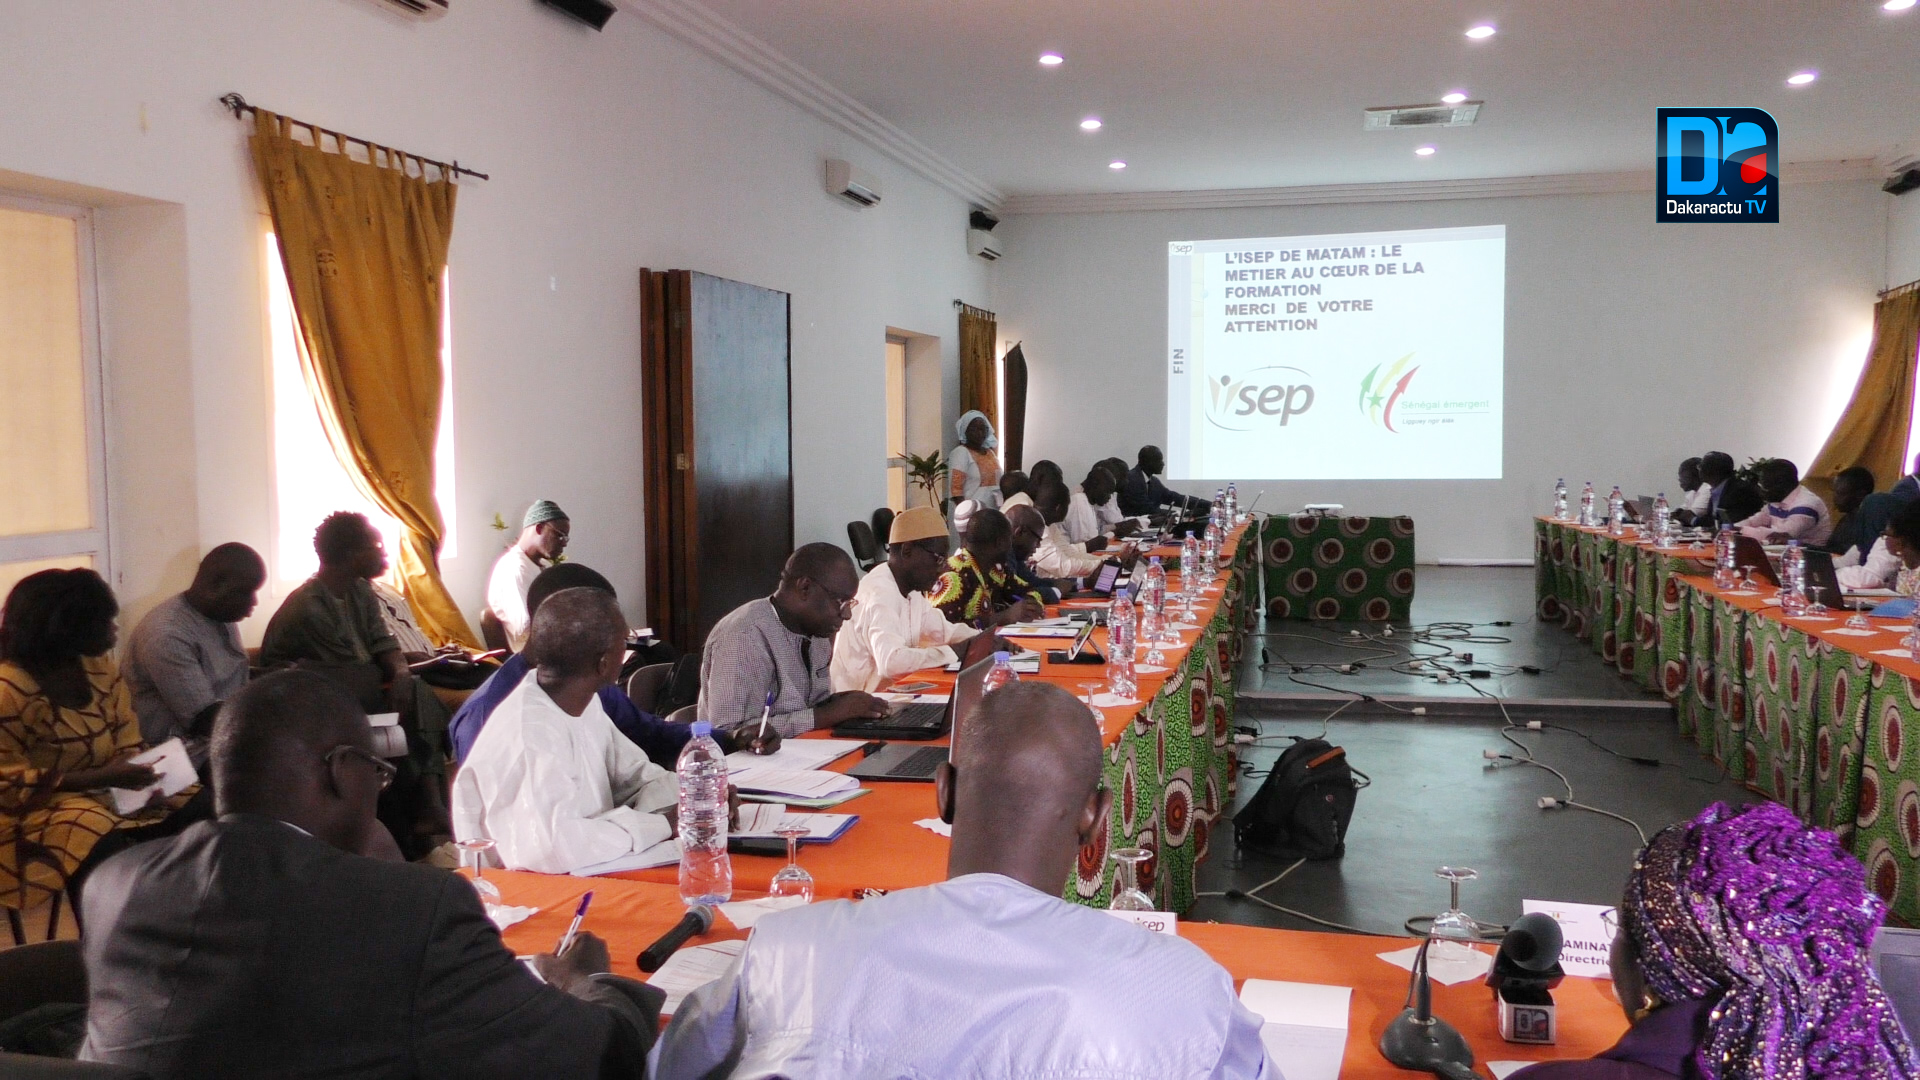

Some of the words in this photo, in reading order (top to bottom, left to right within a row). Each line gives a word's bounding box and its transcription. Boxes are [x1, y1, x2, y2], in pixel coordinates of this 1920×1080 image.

[1225, 251, 1274, 264] L’ISEP
[1280, 250, 1301, 262] DE
[1306, 247, 1366, 261] MATAM
[1381, 245, 1402, 257] LE
[1225, 268, 1286, 281] METIER
[1291, 267, 1314, 279] AU
[1319, 264, 1370, 278] CŒUR
[1375, 263, 1397, 275] DE
[1402, 261, 1425, 274] LA
[1225, 283, 1321, 299] FORMATION
[1225, 303, 1275, 316] MERCI
[1286, 302, 1307, 314] DE
[1317, 299, 1373, 313] VOTRE
[1224, 318, 1318, 333] ATTENTION
[1173, 348, 1184, 374] FIN
[1401, 400, 1440, 411] Sénégal
[1443, 400, 1489, 410] émergent
